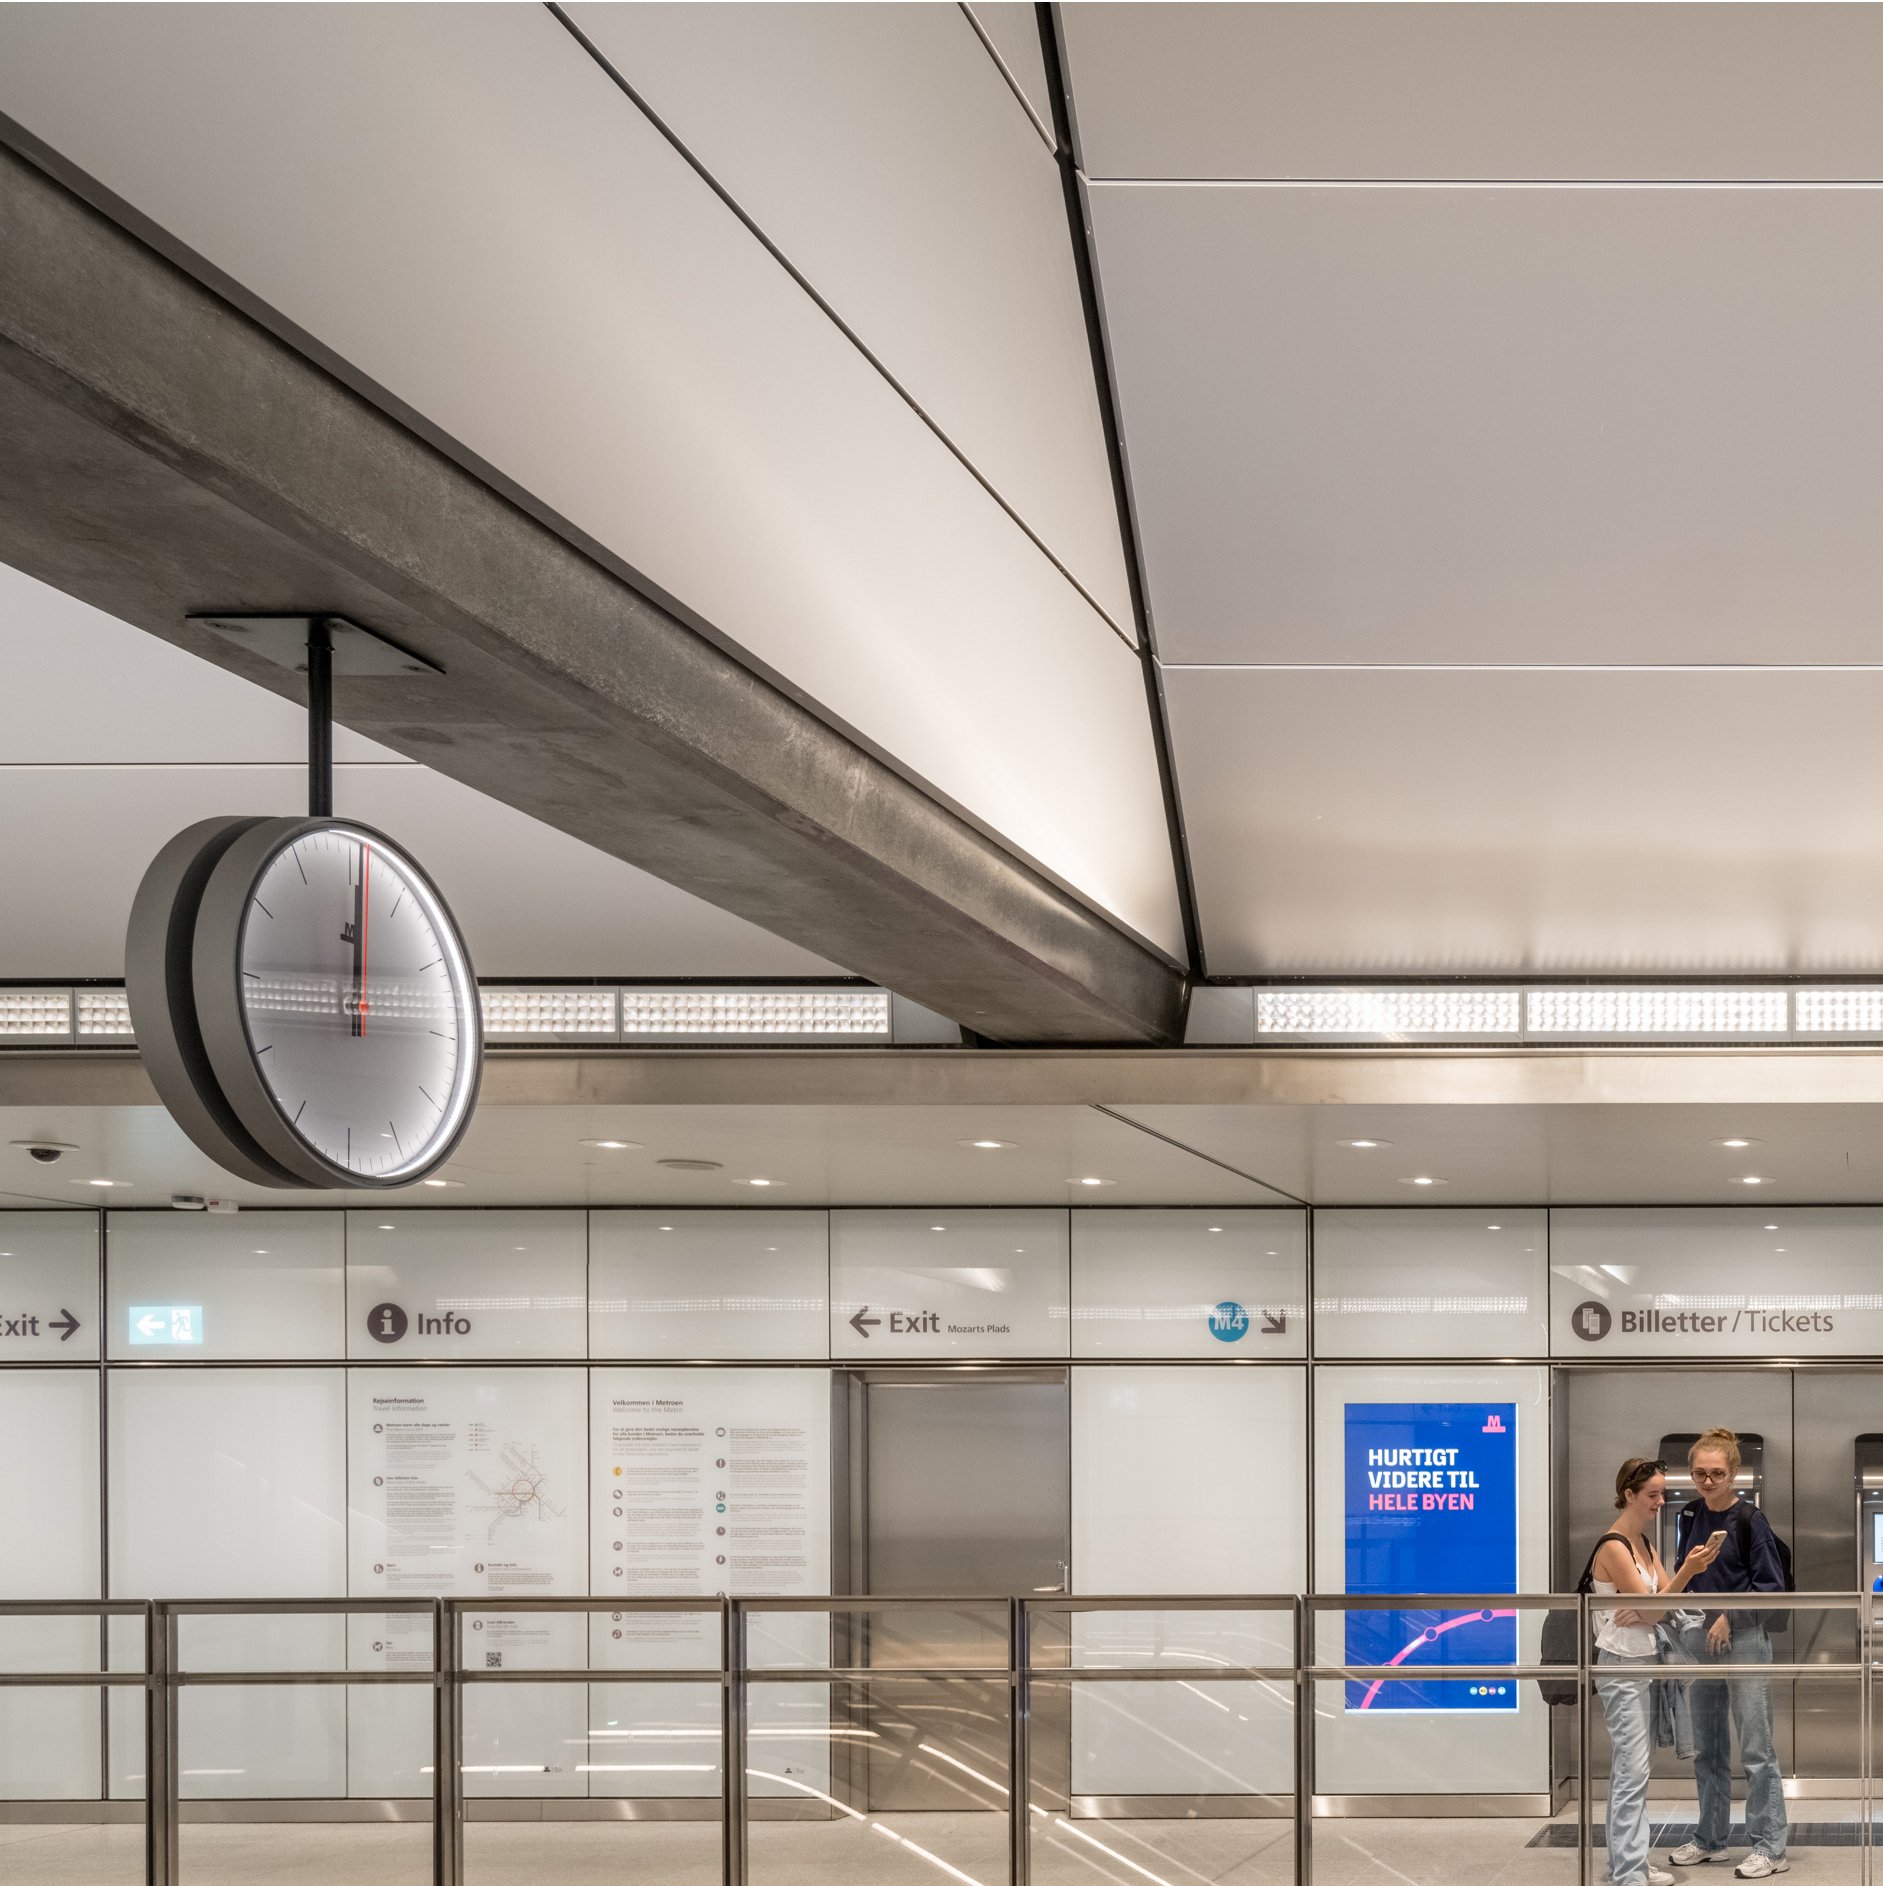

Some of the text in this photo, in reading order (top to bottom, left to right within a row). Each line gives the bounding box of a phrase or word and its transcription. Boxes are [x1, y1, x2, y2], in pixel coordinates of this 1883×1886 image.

[0, 1313, 40, 1336] xit
[418, 1311, 471, 1335] Info
[890, 1311, 1010, 1333] Exit Mozarts Plads
[1214, 1314, 1245, 1330] M4
[373, 1397, 424, 1405] Rejseinformation
[1368, 1449, 1459, 1466] HURTIGT
[1368, 1471, 1480, 1488] VIDERE TIL
[1369, 1494, 1474, 1510] HELE BYEN
